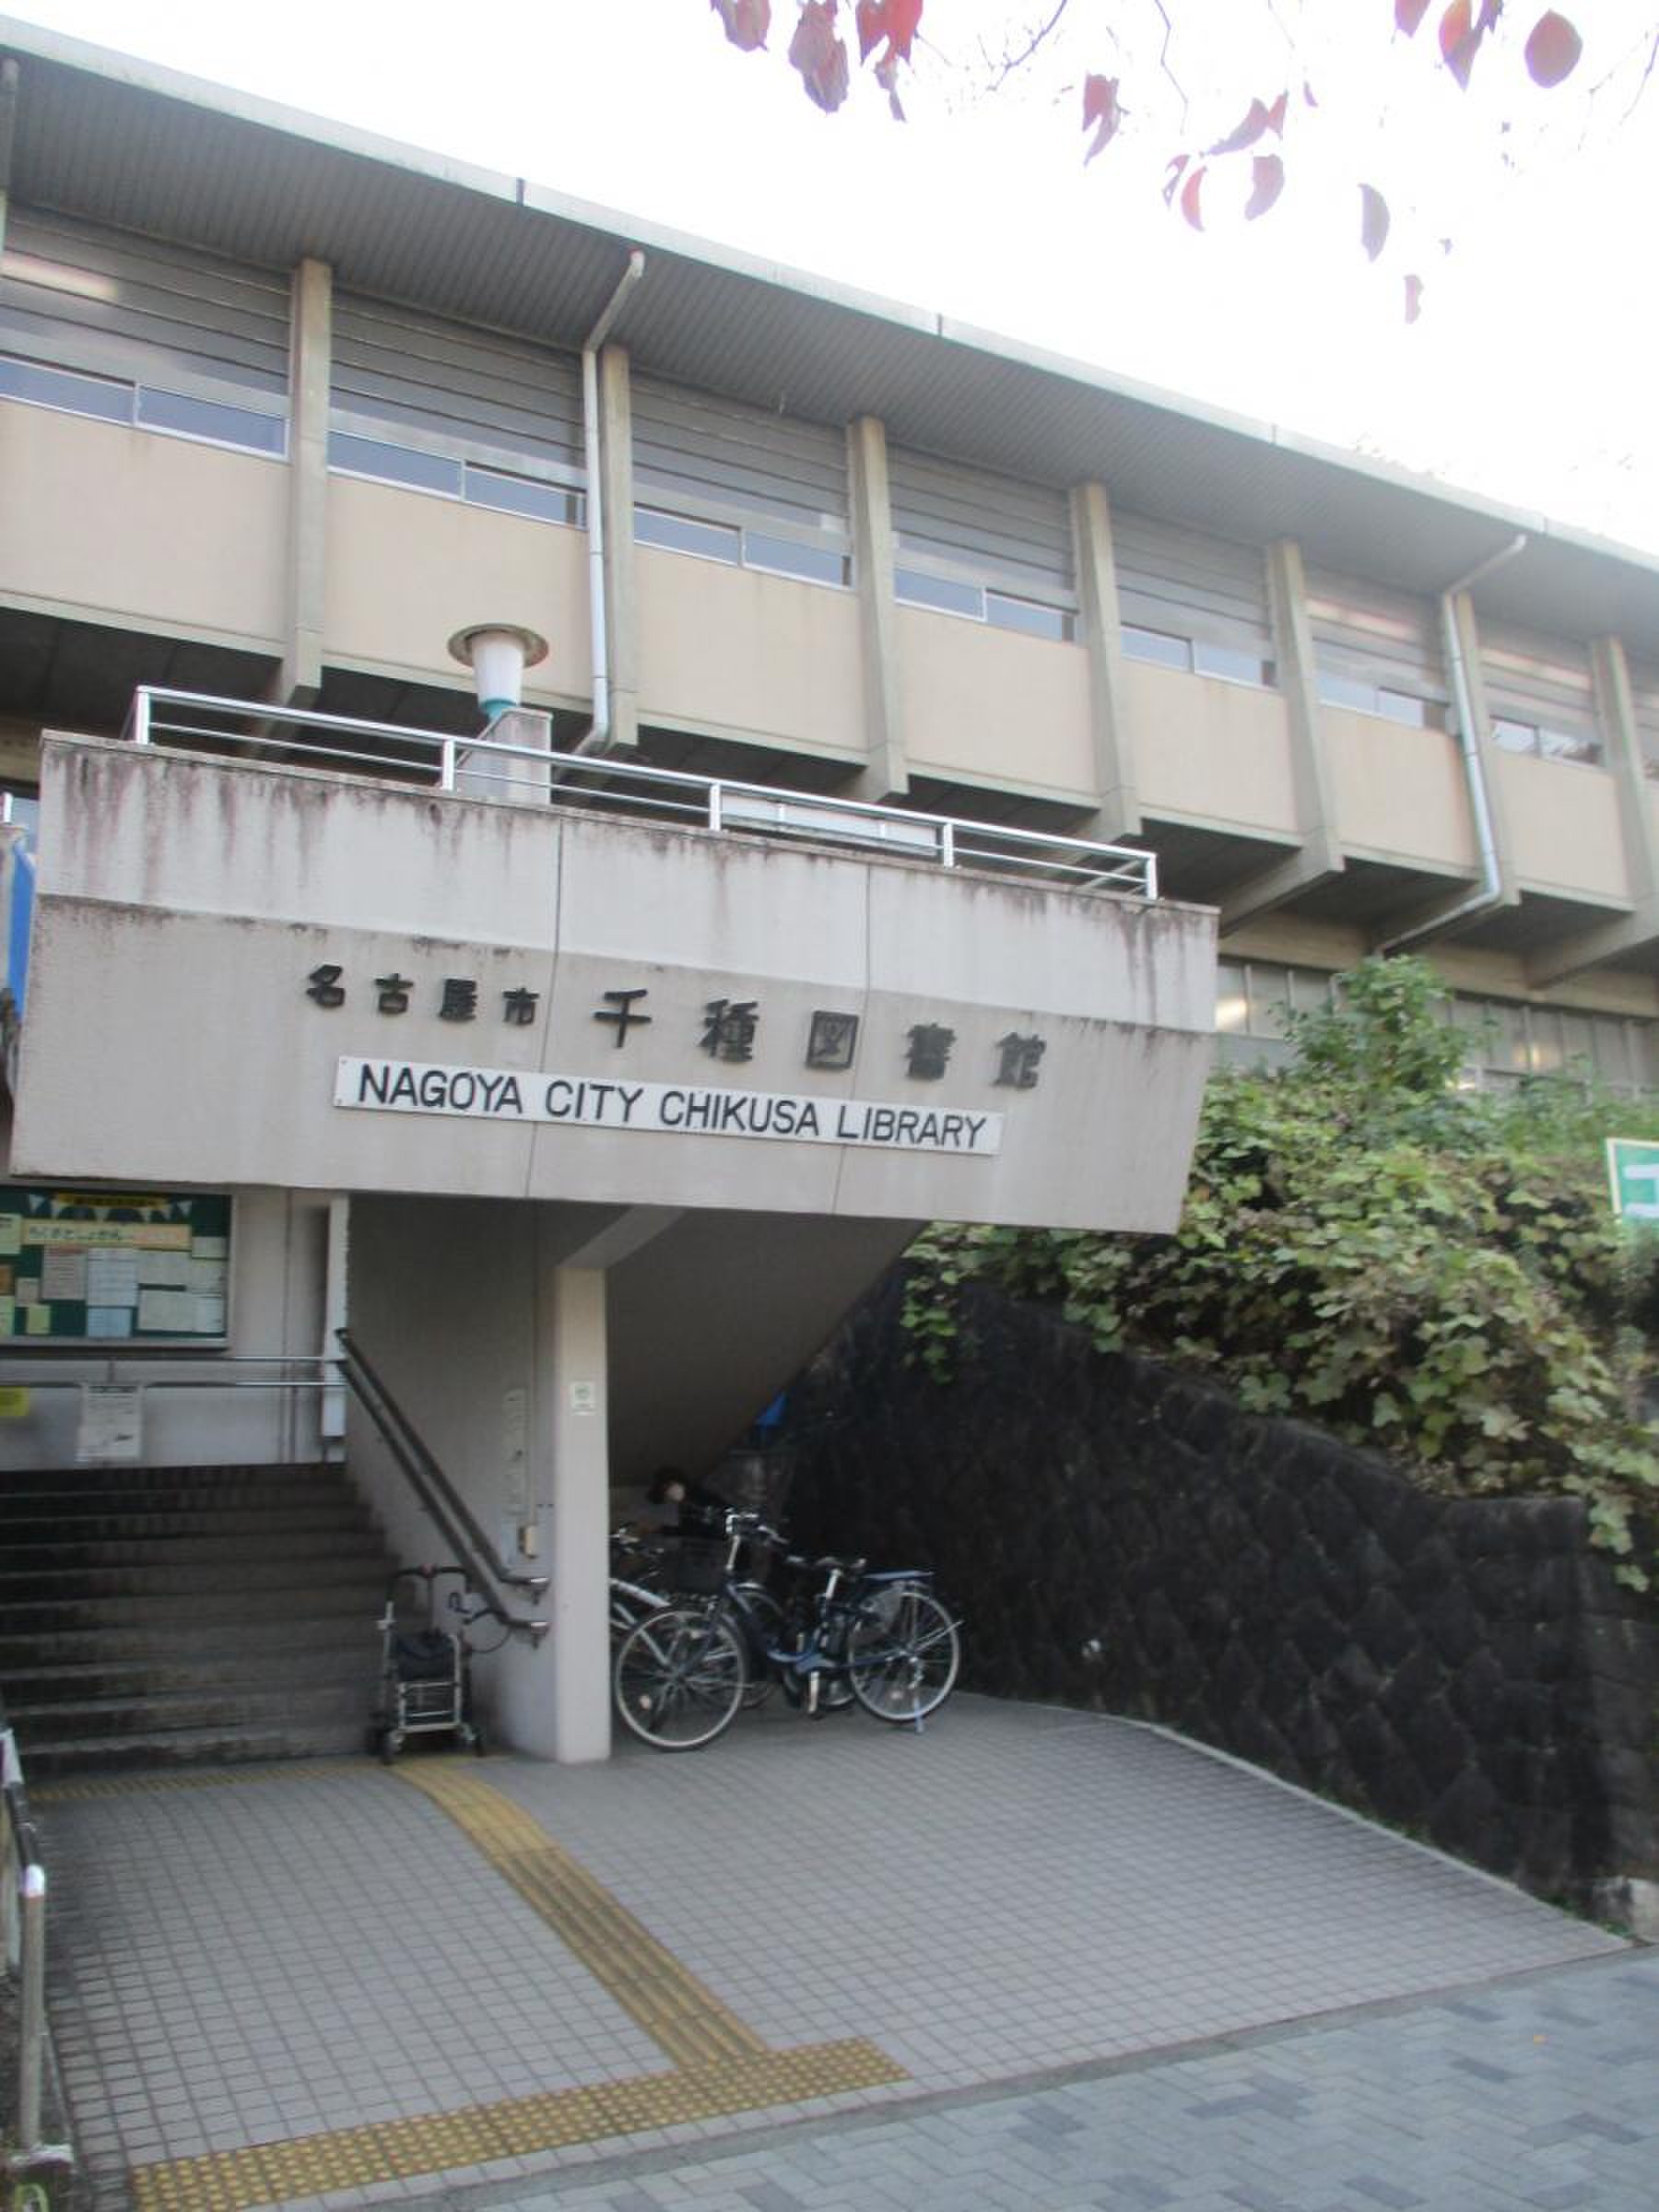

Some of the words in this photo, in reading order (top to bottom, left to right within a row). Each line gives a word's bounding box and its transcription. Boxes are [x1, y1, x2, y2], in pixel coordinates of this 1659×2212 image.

[306, 964, 539, 1026] 名古屋市
[593, 989, 1047, 1089] 千種図書館
[359, 1065, 523, 1114] NAGOYA
[545, 1080, 643, 1124] CITY
[659, 1090, 819, 1136] CHIKUSA
[837, 1104, 987, 1148] LIBRARY
